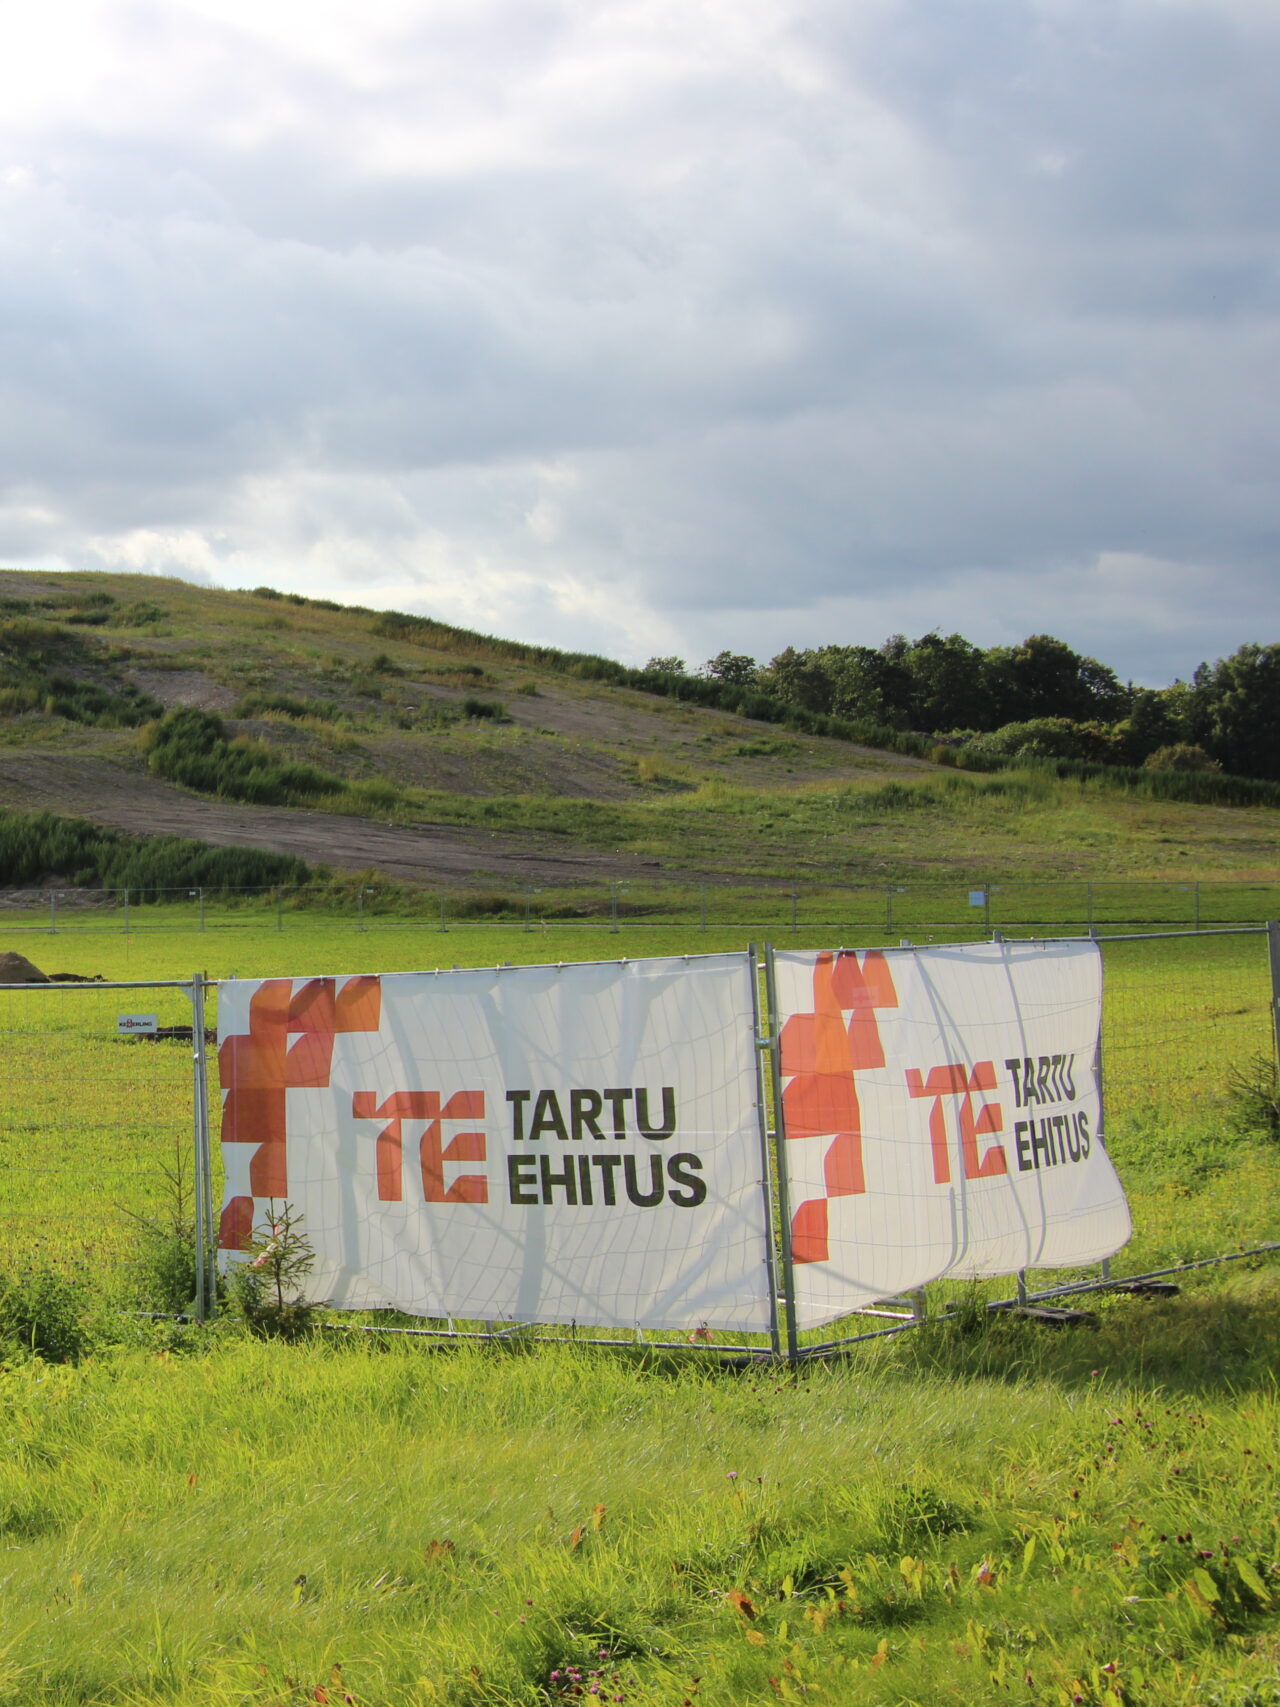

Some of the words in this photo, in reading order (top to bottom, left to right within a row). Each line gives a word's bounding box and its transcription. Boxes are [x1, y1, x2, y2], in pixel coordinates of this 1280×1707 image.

[1004, 1053, 1076, 1108] TARTU
[506, 1086, 676, 1141] TARTU
[905, 1060, 1007, 1184] TE
[1013, 1110, 1090, 1172] EHITUS
[352, 1090, 488, 1203] TE
[507, 1152, 707, 1207] EHITUS
